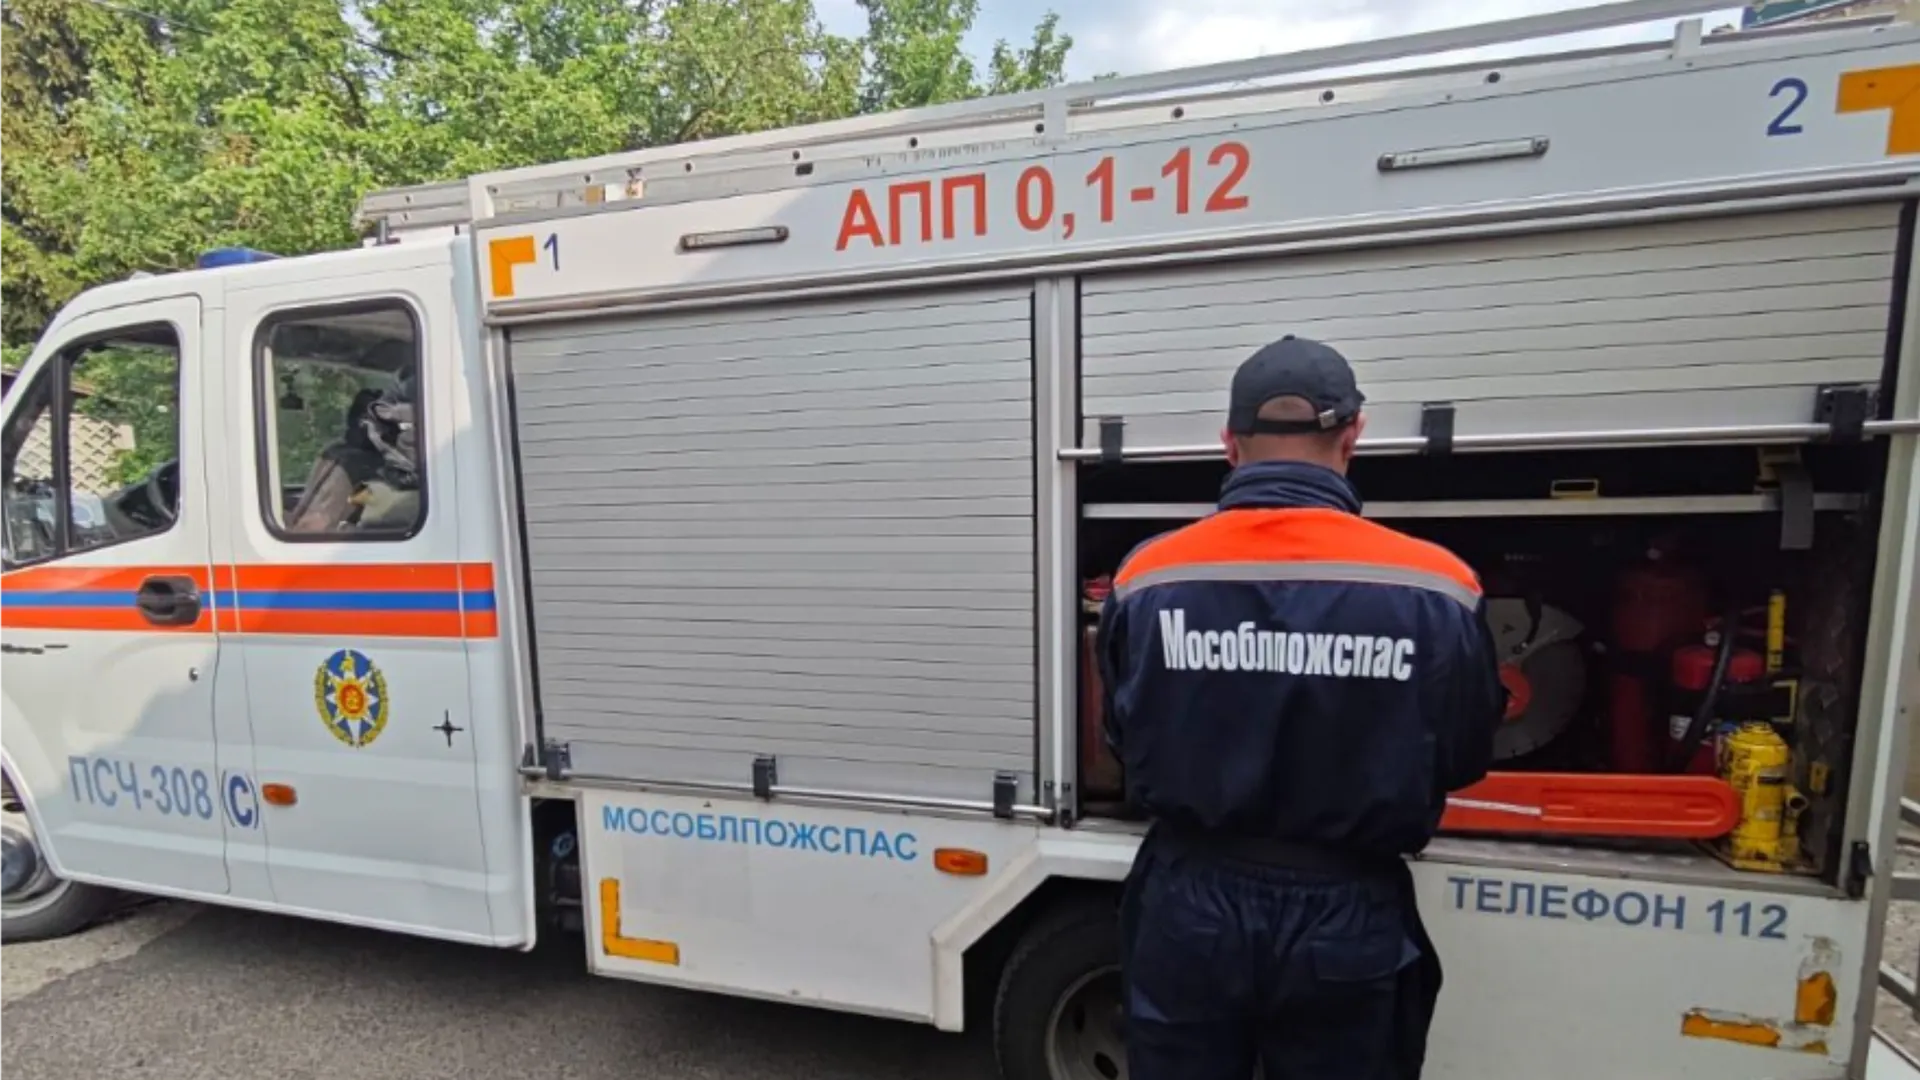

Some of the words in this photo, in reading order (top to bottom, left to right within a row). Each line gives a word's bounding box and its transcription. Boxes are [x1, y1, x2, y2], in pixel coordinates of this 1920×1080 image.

[1766, 77, 1809, 137] 2
[835, 172, 987, 251] АПП
[1015, 140, 1251, 240] 0,1-12
[543, 232, 560, 271] 1
[1158, 608, 1415, 682] Мособлпожспас
[67, 755, 214, 821] ПСЧ-308
[602, 804, 918, 862] МОСОБЛПОЖСПАС
[1447, 876, 1687, 930] ТЕЛЕФОН
[1705, 899, 1789, 940] 112
